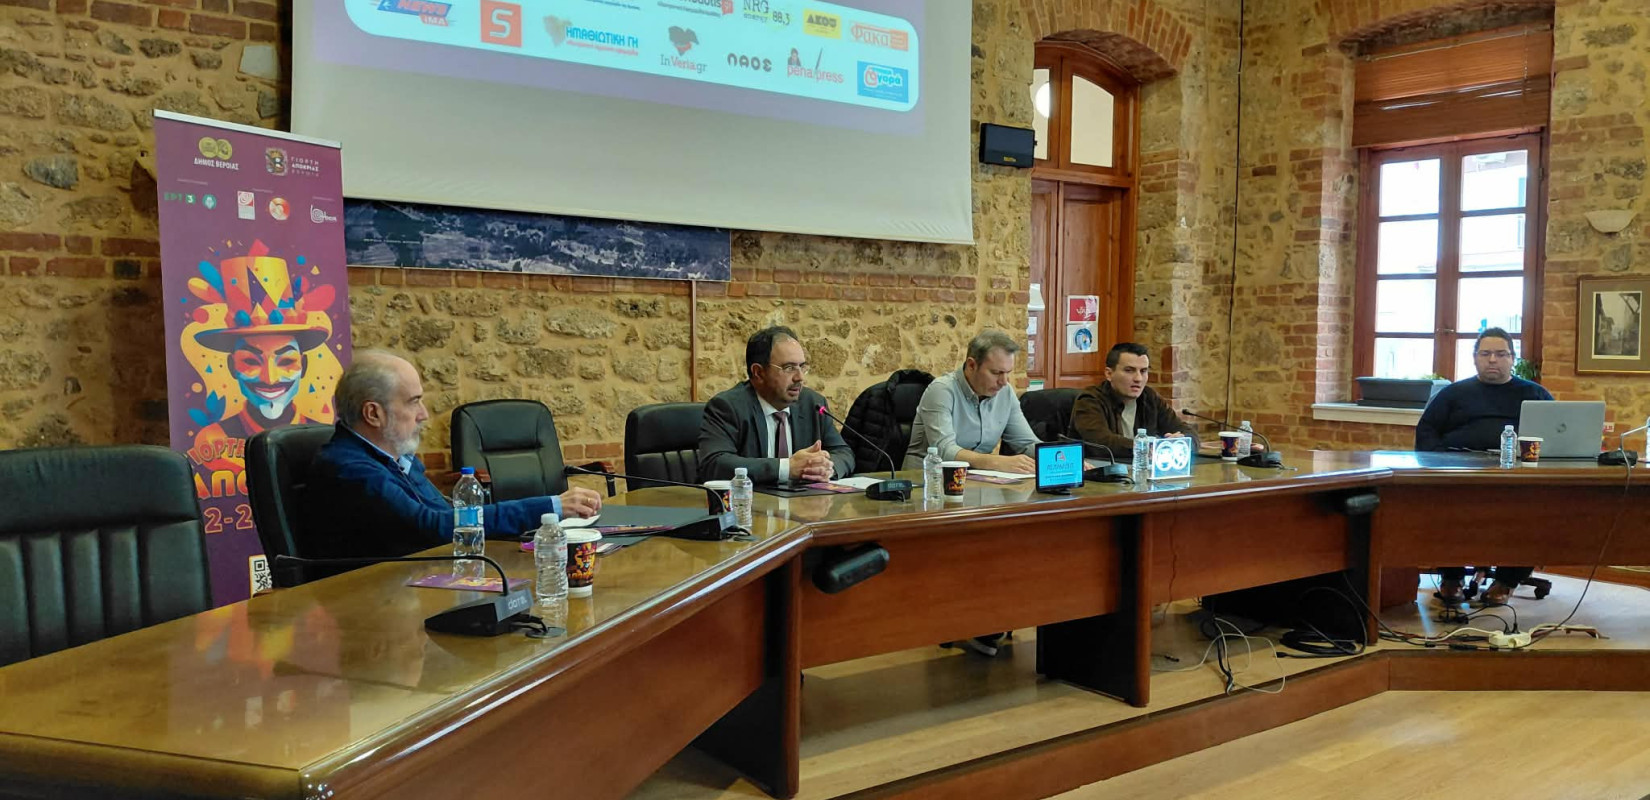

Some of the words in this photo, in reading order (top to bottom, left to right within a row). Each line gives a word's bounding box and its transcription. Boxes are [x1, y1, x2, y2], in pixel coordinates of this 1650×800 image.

[743, 0, 769, 13] NRG
[490, 8, 512, 39] S
[627, 36, 639, 48] ΓΗ
[194, 157, 215, 168] ΔΗΜΟΣ
[216, 160, 239, 171] ΒΕΡΟΙΑΣ
[184, 437, 246, 465] ΙΟΡΤΗ
